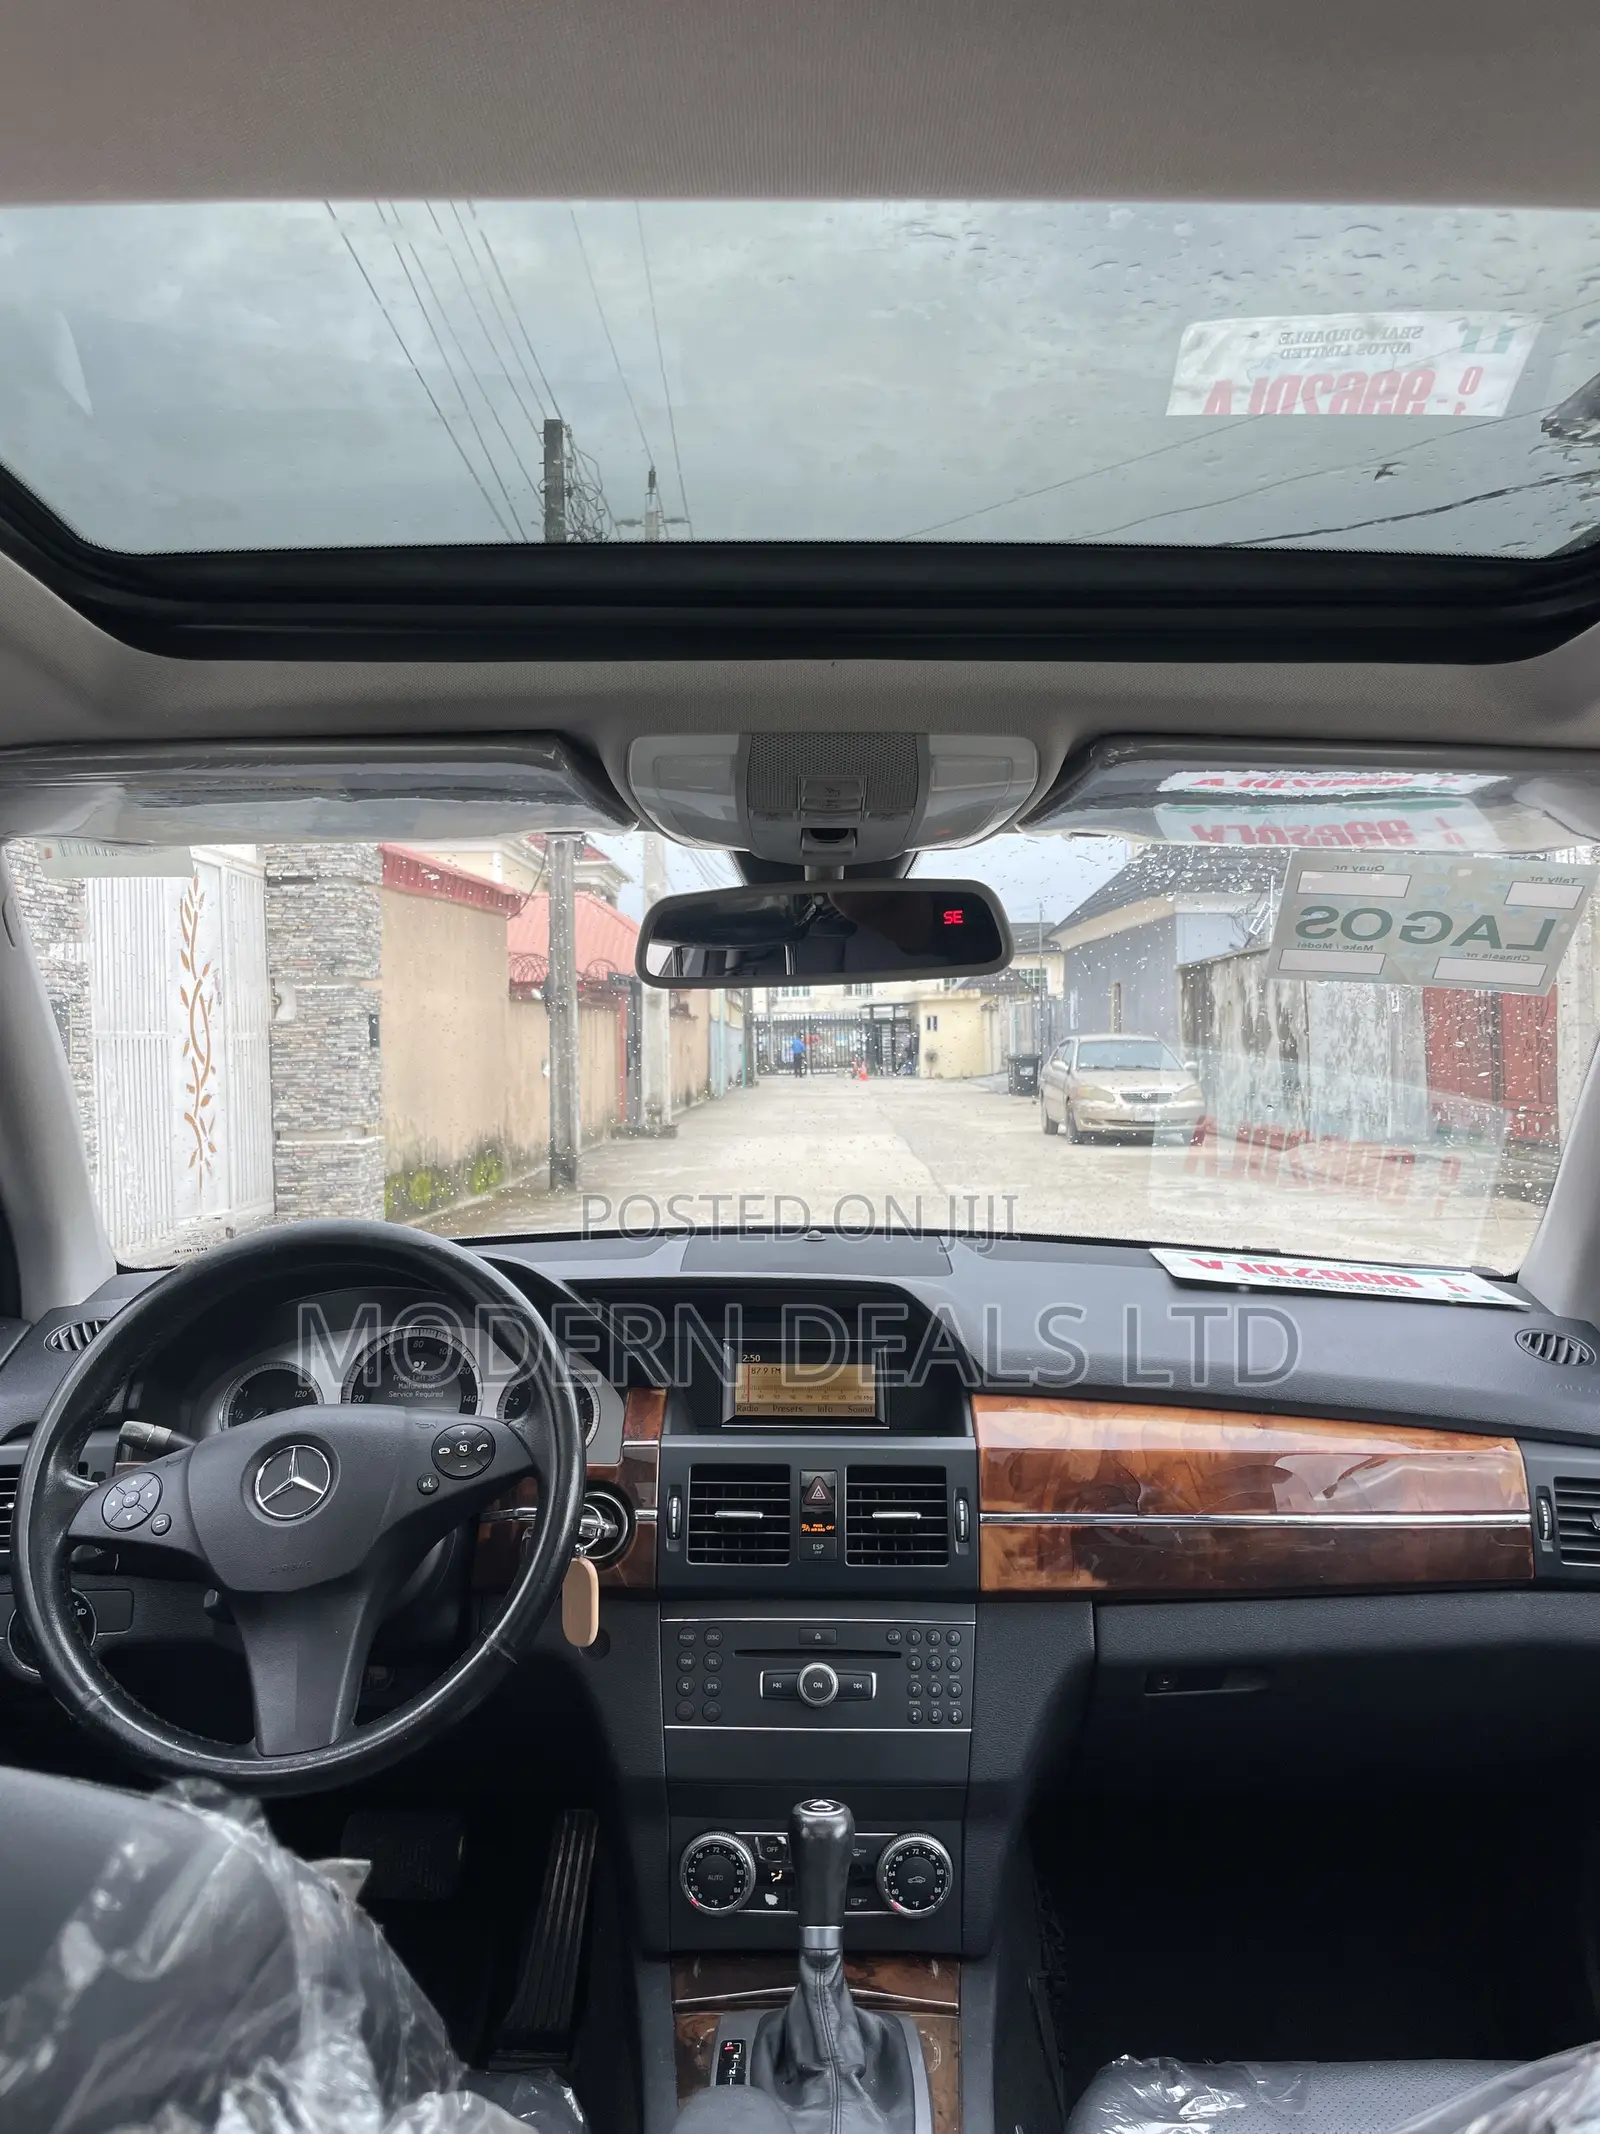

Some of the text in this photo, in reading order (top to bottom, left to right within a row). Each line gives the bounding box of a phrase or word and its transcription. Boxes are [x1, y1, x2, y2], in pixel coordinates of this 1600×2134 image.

[943, 909, 964, 925] SE
[412, 1340, 424, 1348] 80
[742, 1354, 761, 1362] 2:50
[294, 1390, 308, 1398] 120
[388, 1390, 444, 1399] Service Required
[353, 1395, 364, 1403] 20
[462, 1395, 477, 1403] 140
[736, 1405, 873, 1413] Radio Presets Info Sound
